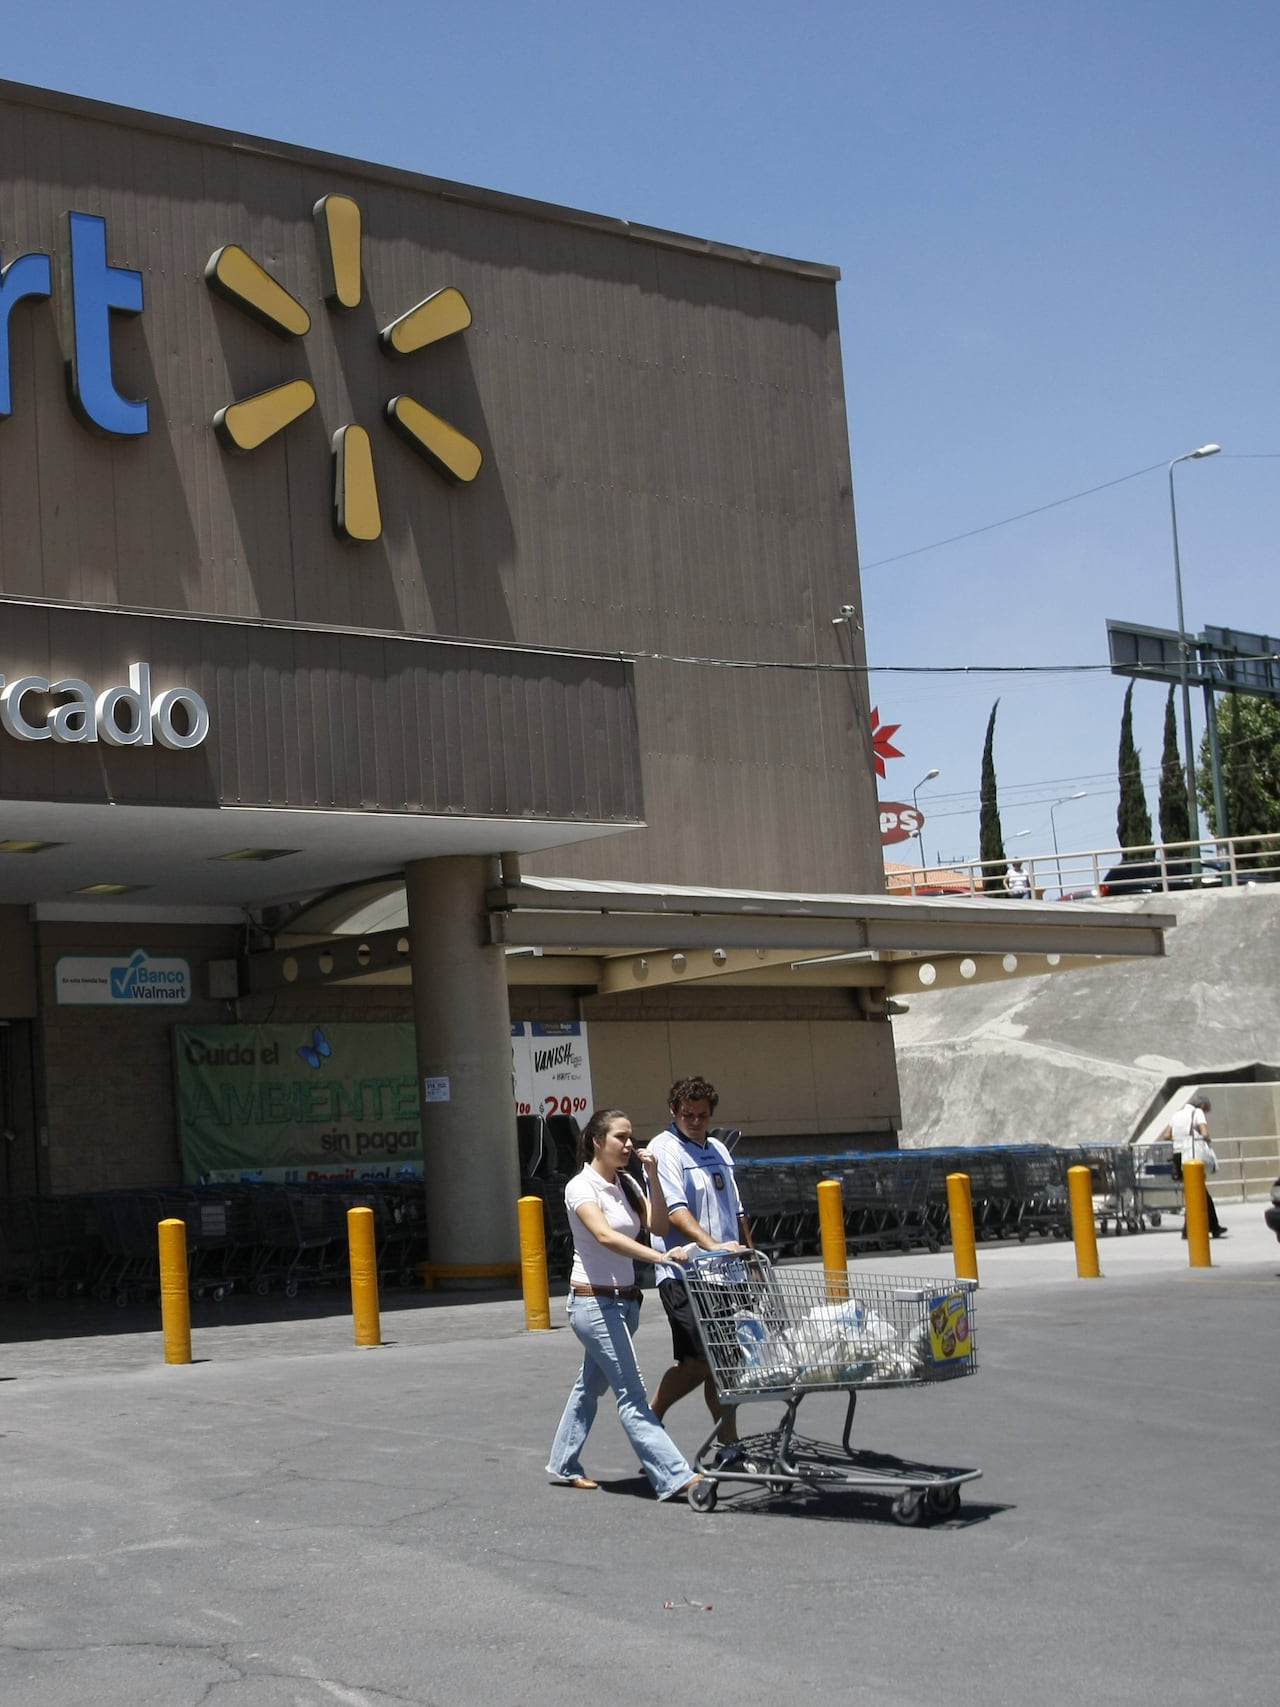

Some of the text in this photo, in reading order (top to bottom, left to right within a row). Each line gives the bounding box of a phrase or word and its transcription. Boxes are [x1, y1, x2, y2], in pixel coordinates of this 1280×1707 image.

[879, 810, 919, 834] ps
[137, 967, 185, 984] Banco
[132, 985, 187, 999] Walmart
[185, 1038, 280, 1067] Cuida el
[534, 1043, 572, 1072] VANISH
[184, 1078, 421, 1127] AMBIENTE
[321, 1128, 420, 1156] sin pagar
